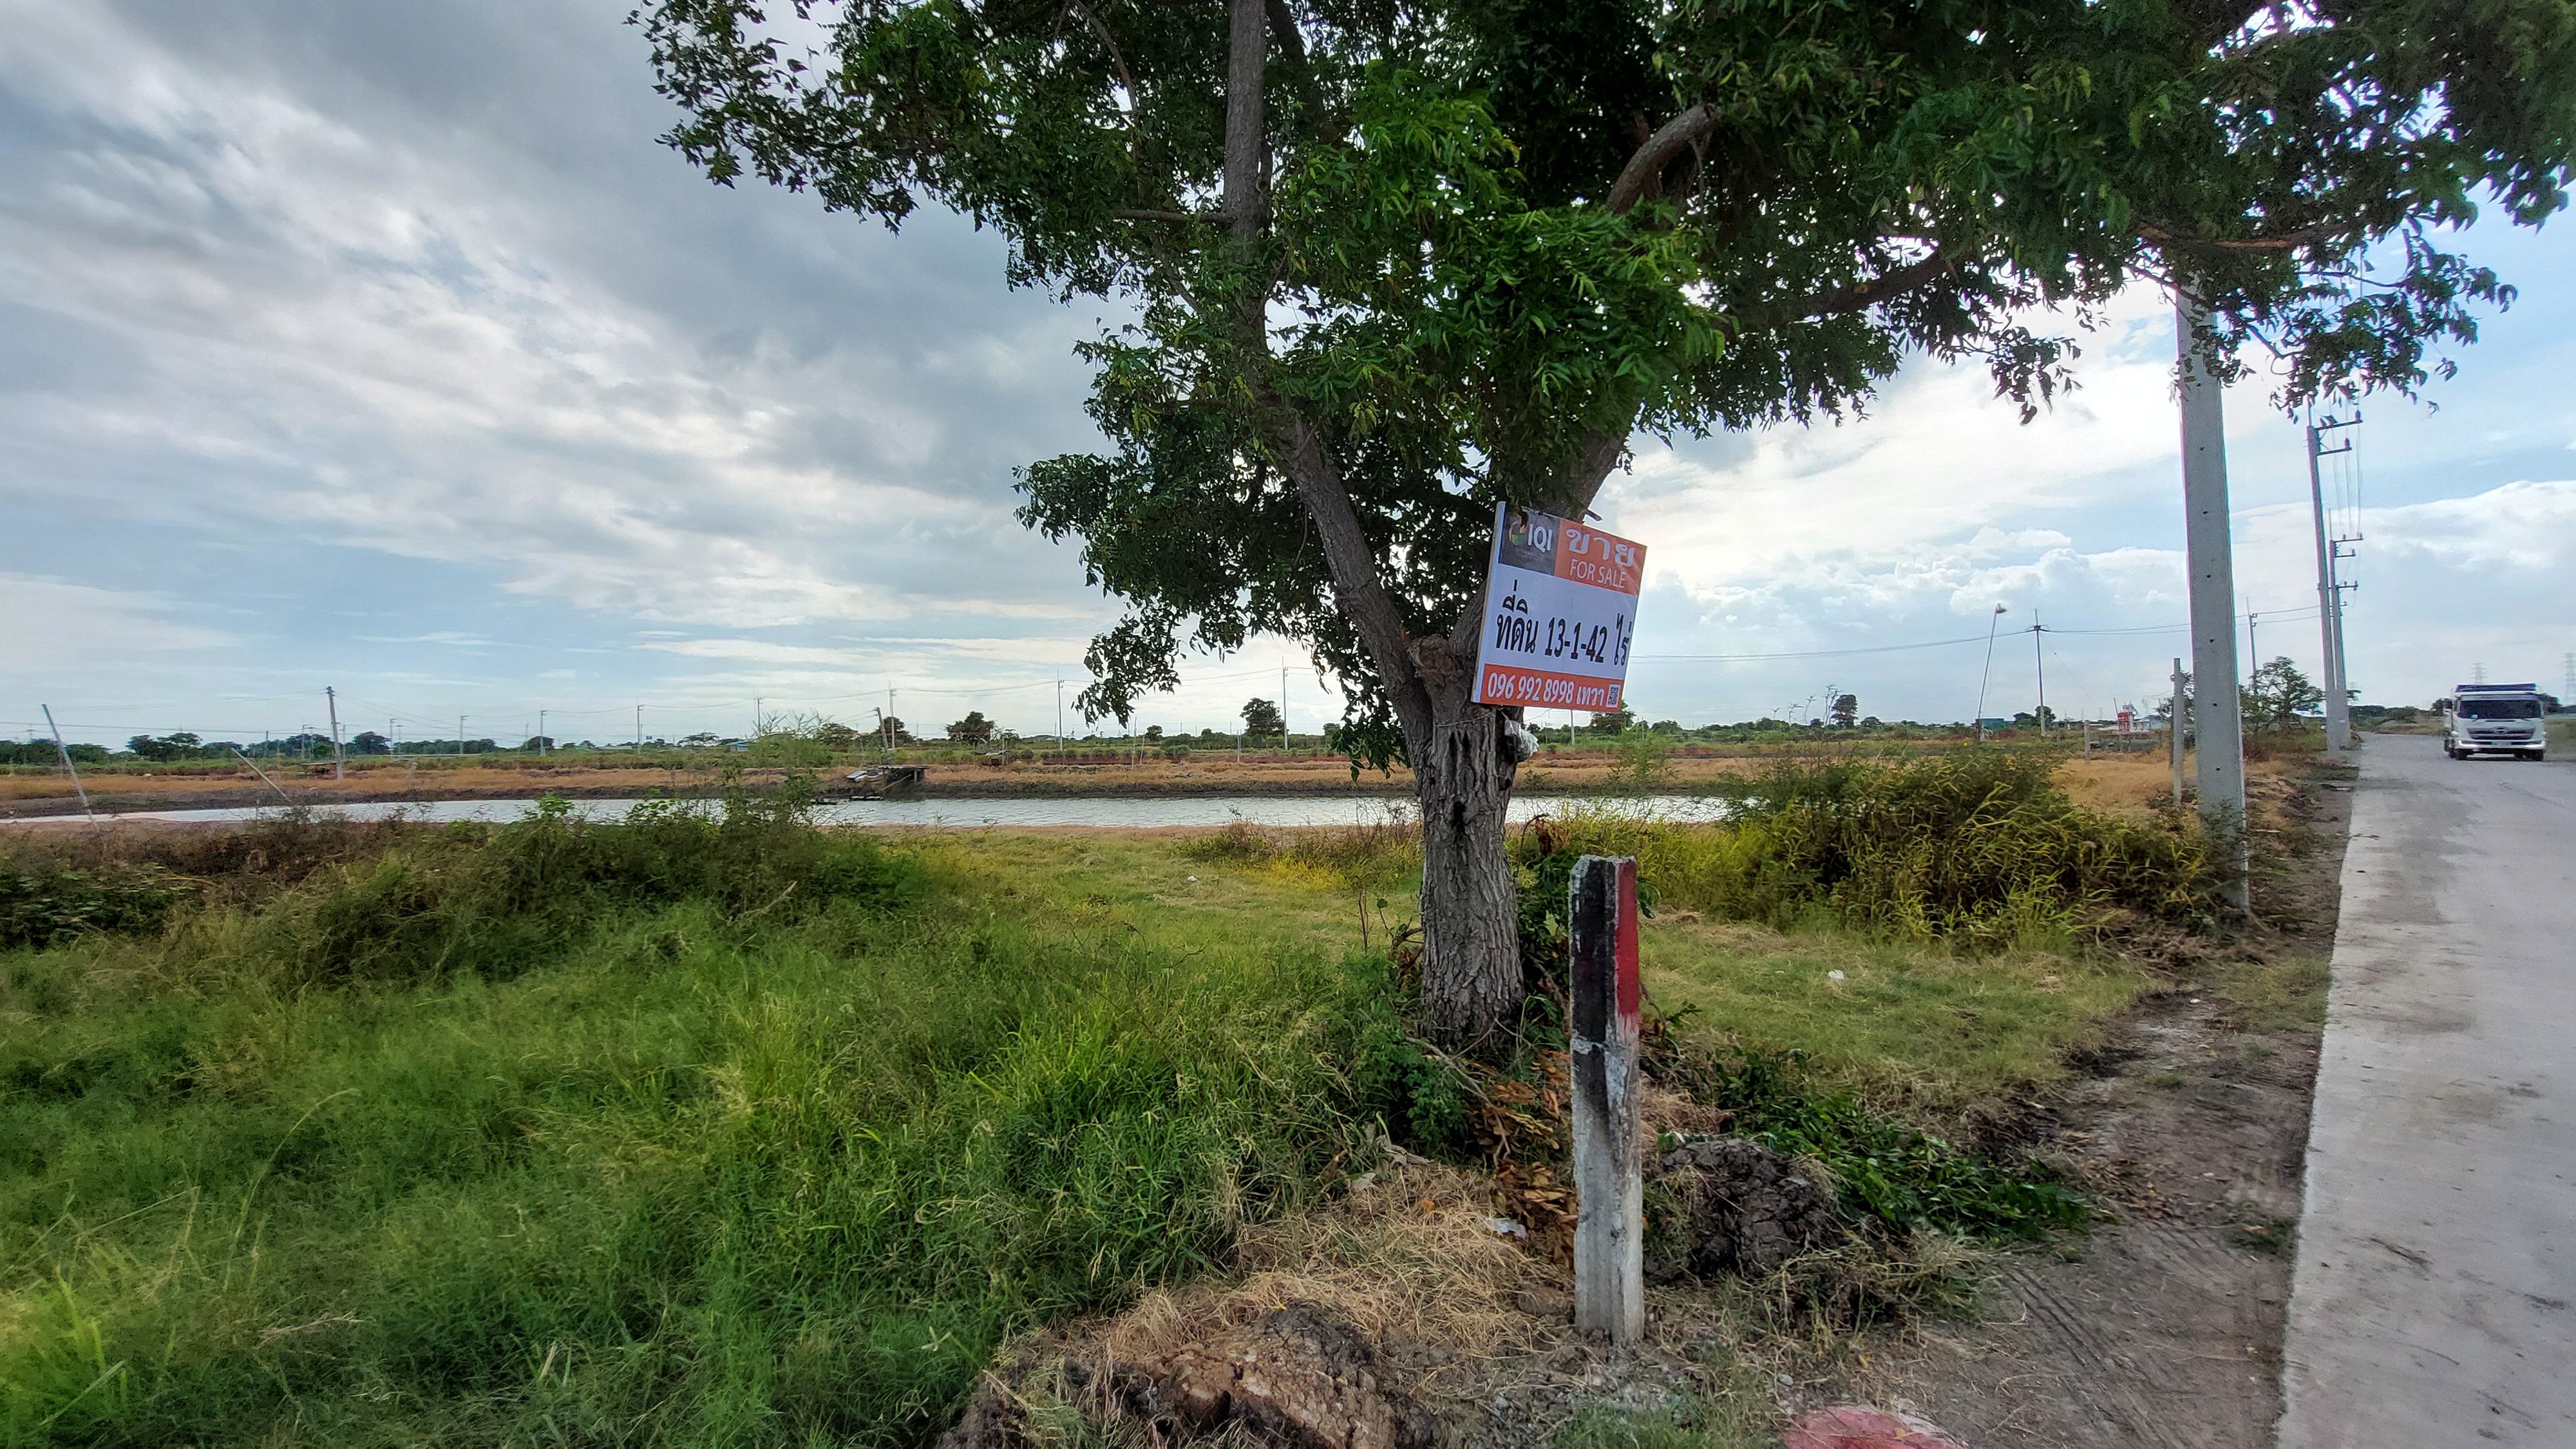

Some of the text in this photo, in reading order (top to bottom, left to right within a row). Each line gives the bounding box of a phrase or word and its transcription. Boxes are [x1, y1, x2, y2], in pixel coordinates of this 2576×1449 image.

[1528, 524, 1553, 553] IQI
[1566, 528, 1635, 567] ขาย
[1569, 559, 1627, 589] FOR SALE
[1495, 579, 1633, 667] ที่ดิน 13-1-42 ไร่
[1488, 672, 1516, 699] 096
[1517, 676, 1542, 701] 992
[1543, 679, 1575, 704] 8998
